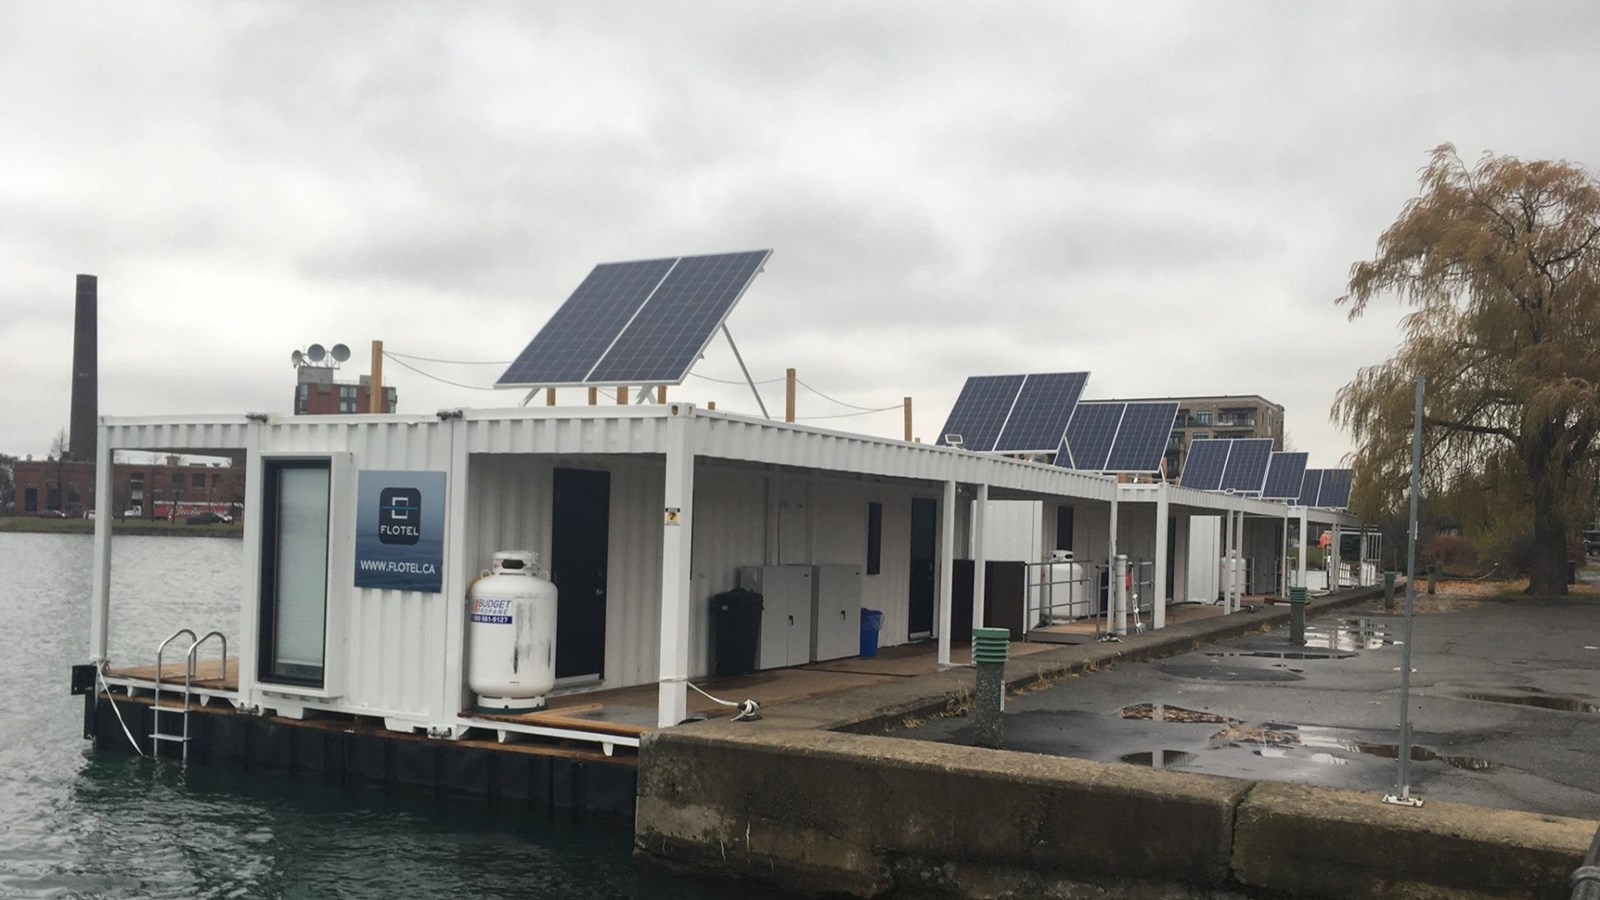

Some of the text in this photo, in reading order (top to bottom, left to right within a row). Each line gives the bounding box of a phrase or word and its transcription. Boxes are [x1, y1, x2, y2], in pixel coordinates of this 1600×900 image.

[380, 525, 419, 536] FLOTEL
[360, 559, 436, 575] WWW.FLOTEL.CA
[479, 599, 512, 608] BUDGET
